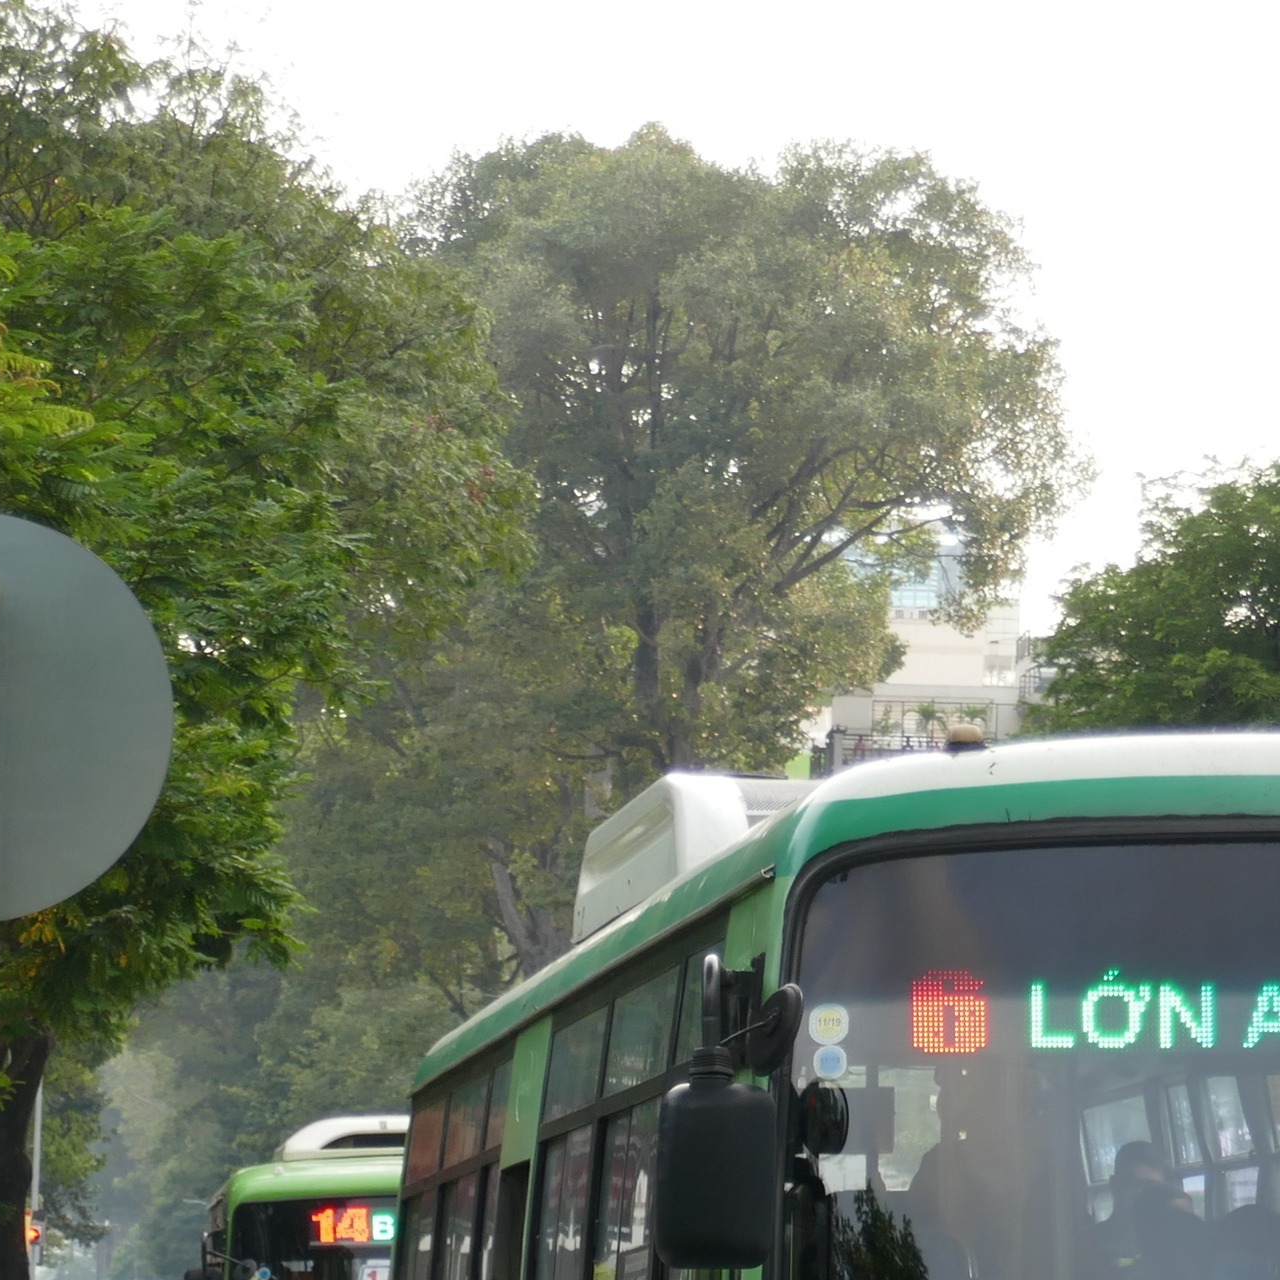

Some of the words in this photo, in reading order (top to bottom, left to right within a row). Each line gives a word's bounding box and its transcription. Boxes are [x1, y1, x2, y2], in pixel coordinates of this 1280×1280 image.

[1030, 968, 1214, 1049] LỚN
[311, 1208, 369, 1243] 14
[372, 1215, 396, 1241] B
